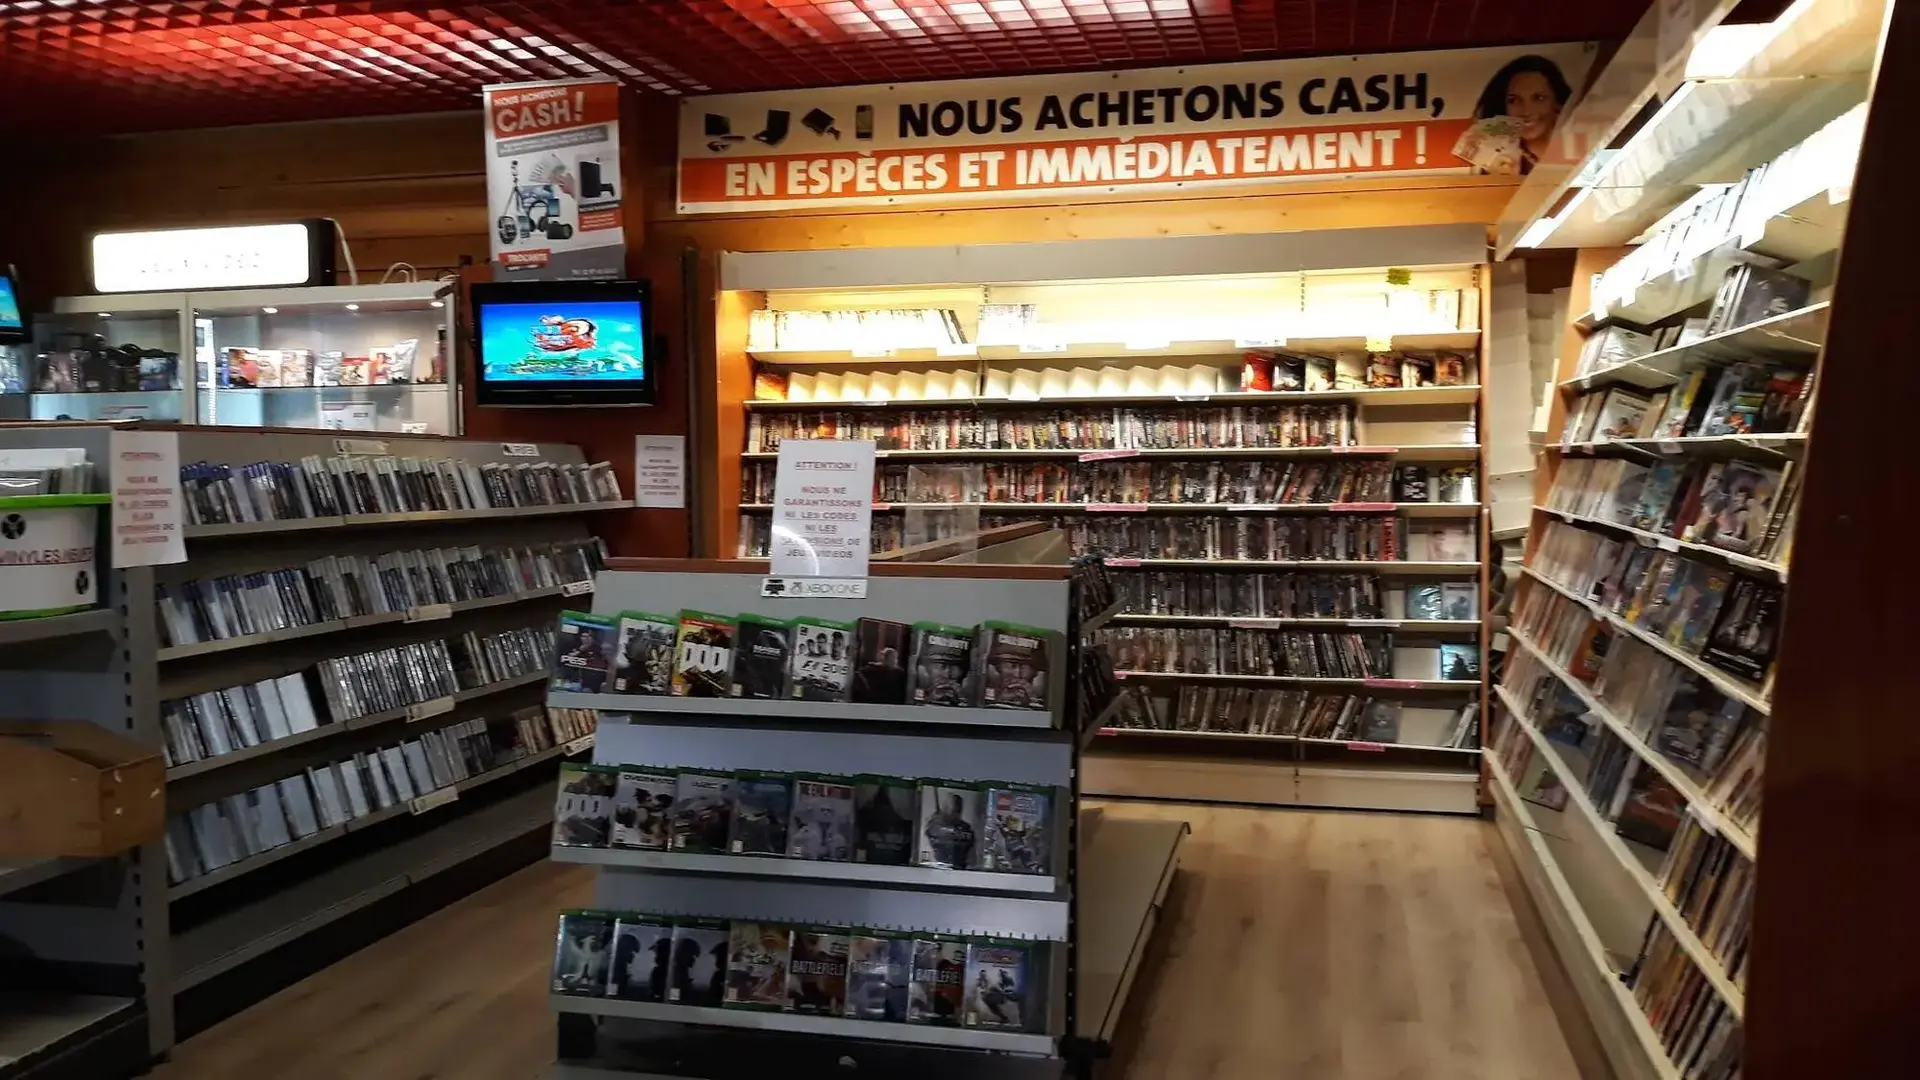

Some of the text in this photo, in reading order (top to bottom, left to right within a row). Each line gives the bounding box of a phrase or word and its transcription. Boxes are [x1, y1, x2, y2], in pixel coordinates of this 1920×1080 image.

[898, 72, 1444, 138] NOUS ACHETONS CASH,
[725, 126, 1427, 197] EN ESPÈCES ET IMMÉDIATEMENT !
[795, 461, 851, 470] ATTENTION
[801, 486, 846, 494] NOUS NE
[783, 498, 862, 507] GARANTISSONS
[801, 511, 819, 519] LES
[822, 511, 857, 520] CODES
[818, 524, 837, 532] LES
[847, 537, 860, 545] DE
[786, 549, 810, 557] JEU
[560, 655, 588, 666] PES
